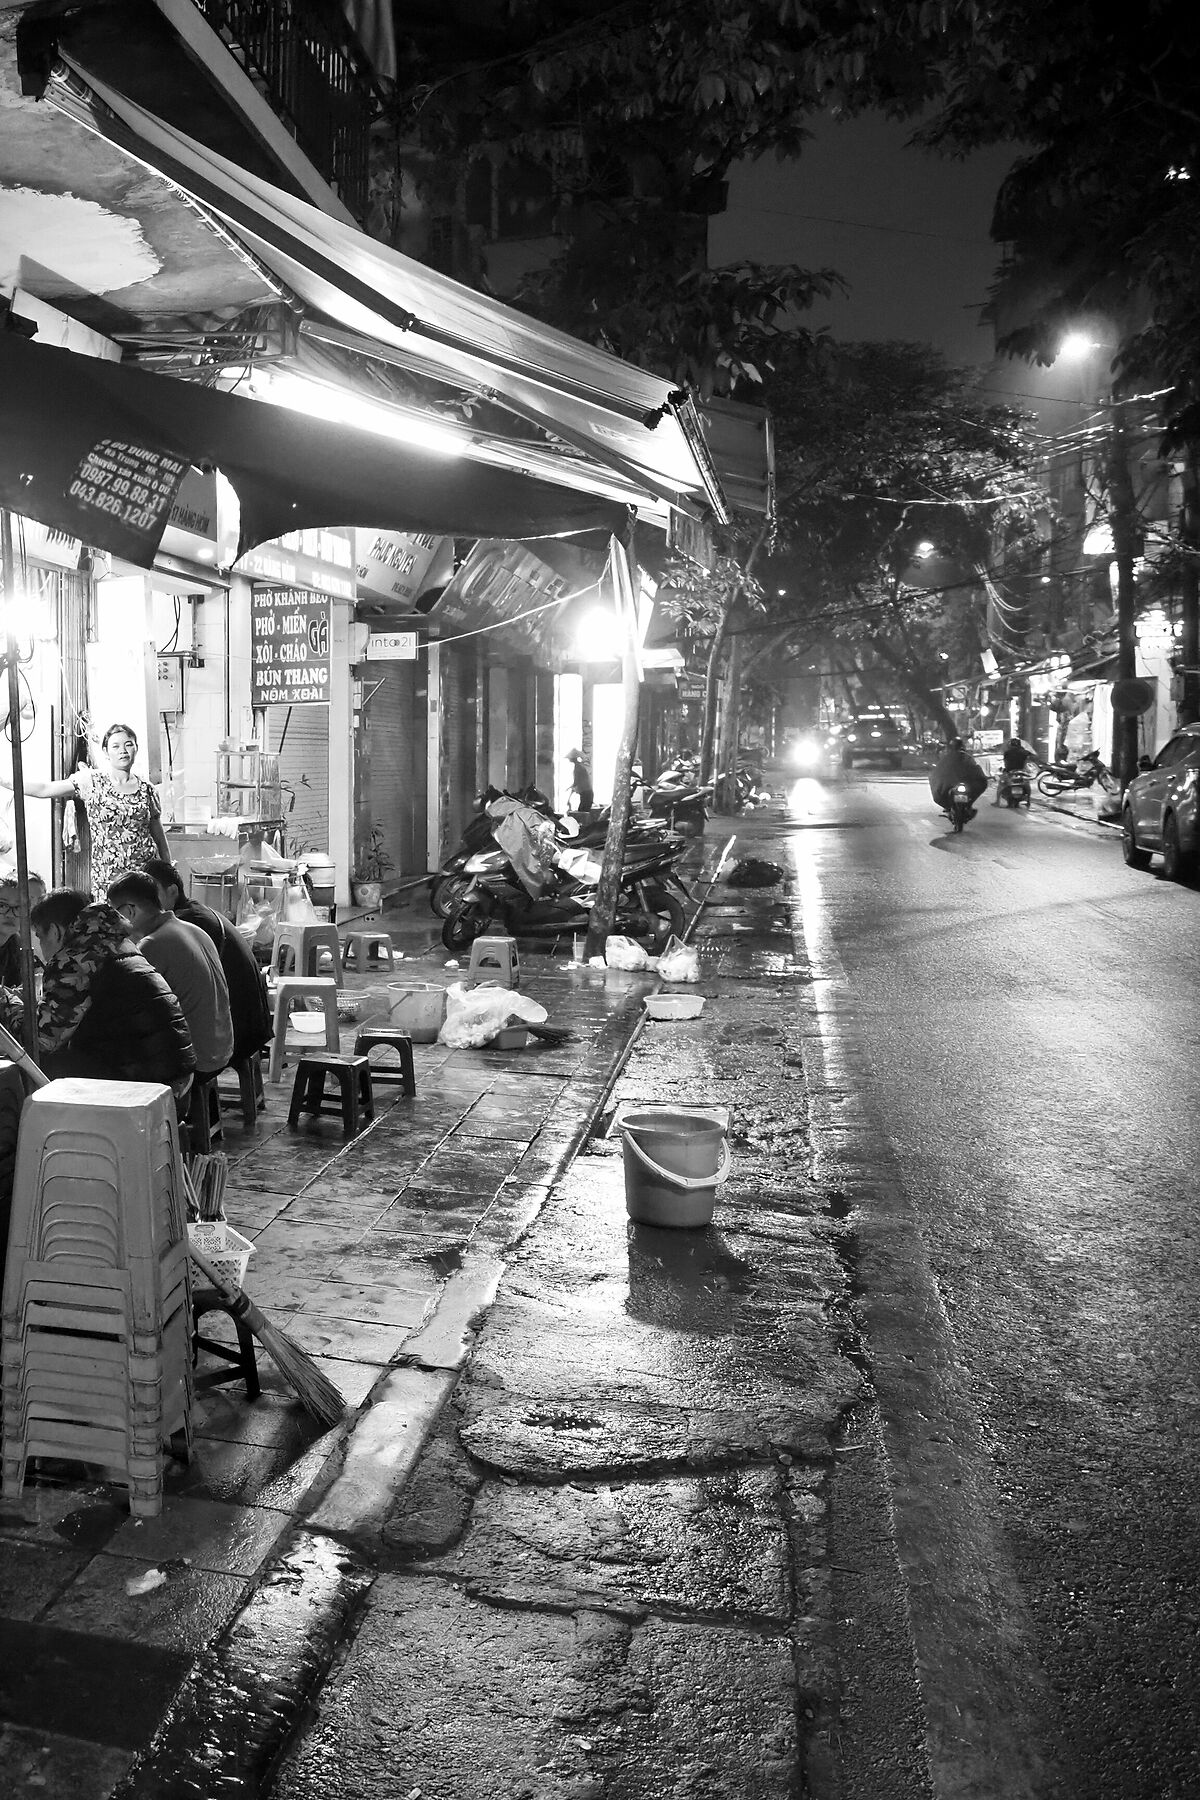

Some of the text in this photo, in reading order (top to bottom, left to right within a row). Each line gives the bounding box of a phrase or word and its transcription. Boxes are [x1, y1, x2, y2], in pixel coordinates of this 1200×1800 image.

[160, 458, 183, 475] MAI
[80, 463, 167, 513] 0987.99.88.31
[69, 480, 158, 531] 043.826.1207
[274, 588, 308, 606] KHÁNH
[256, 640, 274, 664] XÔI
[280, 638, 307, 663] CHÁO
[256, 666, 328, 686] BÚN THANG
